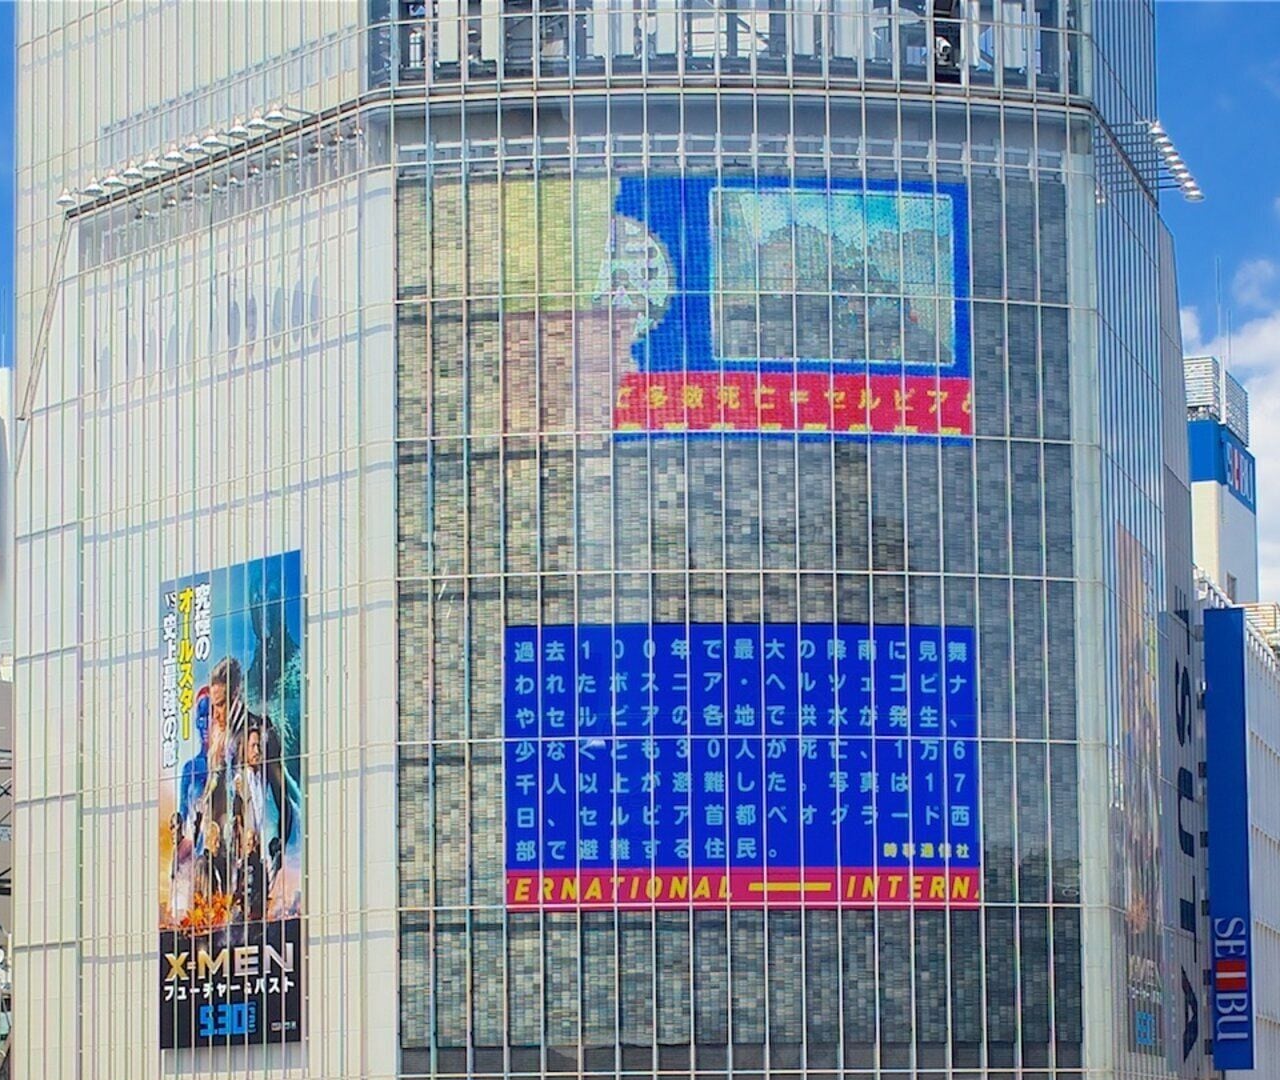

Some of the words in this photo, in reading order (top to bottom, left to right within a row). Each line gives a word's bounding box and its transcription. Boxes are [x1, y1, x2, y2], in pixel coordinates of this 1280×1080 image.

[178, 587, 194, 740] オールスター
[1214, 916, 1249, 1042] SEIBU
